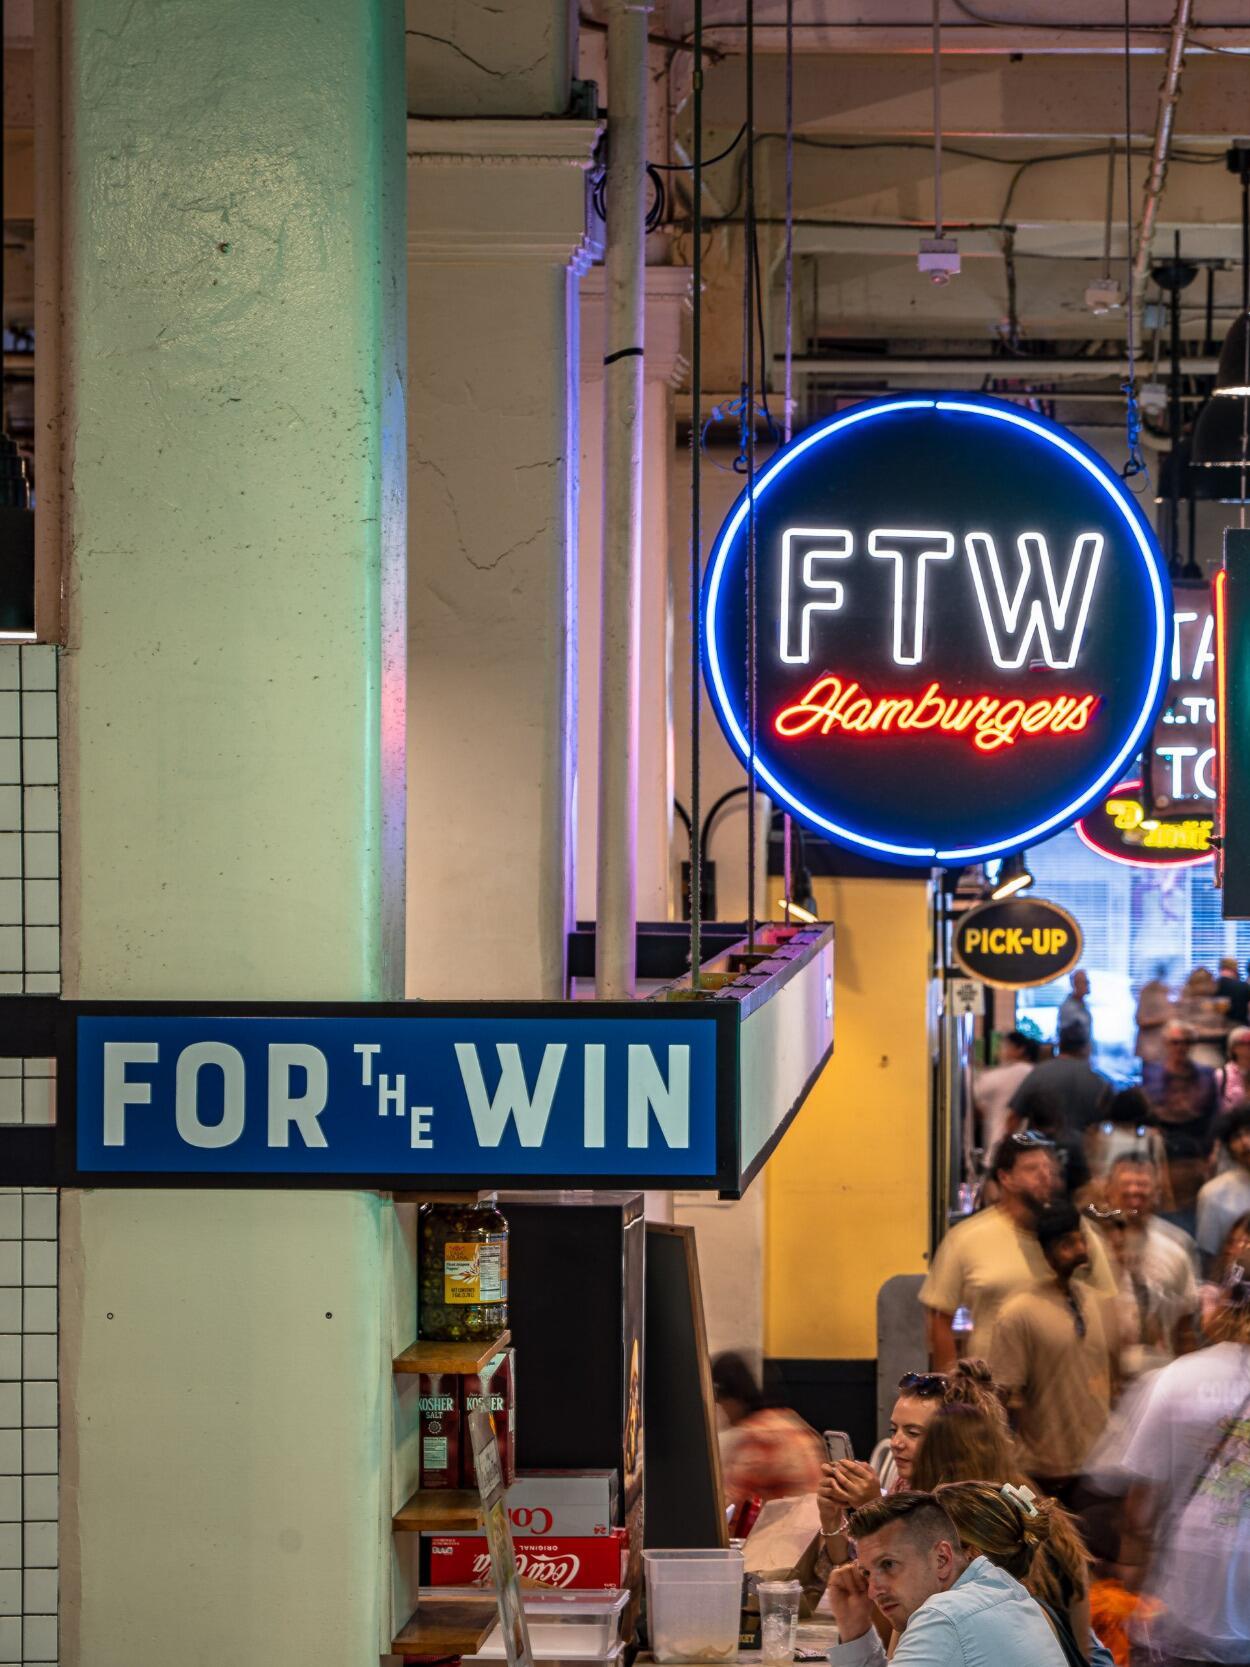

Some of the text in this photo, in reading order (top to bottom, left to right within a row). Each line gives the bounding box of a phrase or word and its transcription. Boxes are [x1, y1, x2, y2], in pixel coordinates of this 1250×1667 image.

[779, 527, 1105, 670] FTW
[774, 676, 1096, 751] Hamburgers
[964, 927, 1069, 956] PICK-UP
[103, 1041, 691, 1149] FOR THE WIN
[425, 1411, 443, 1419] SALT
